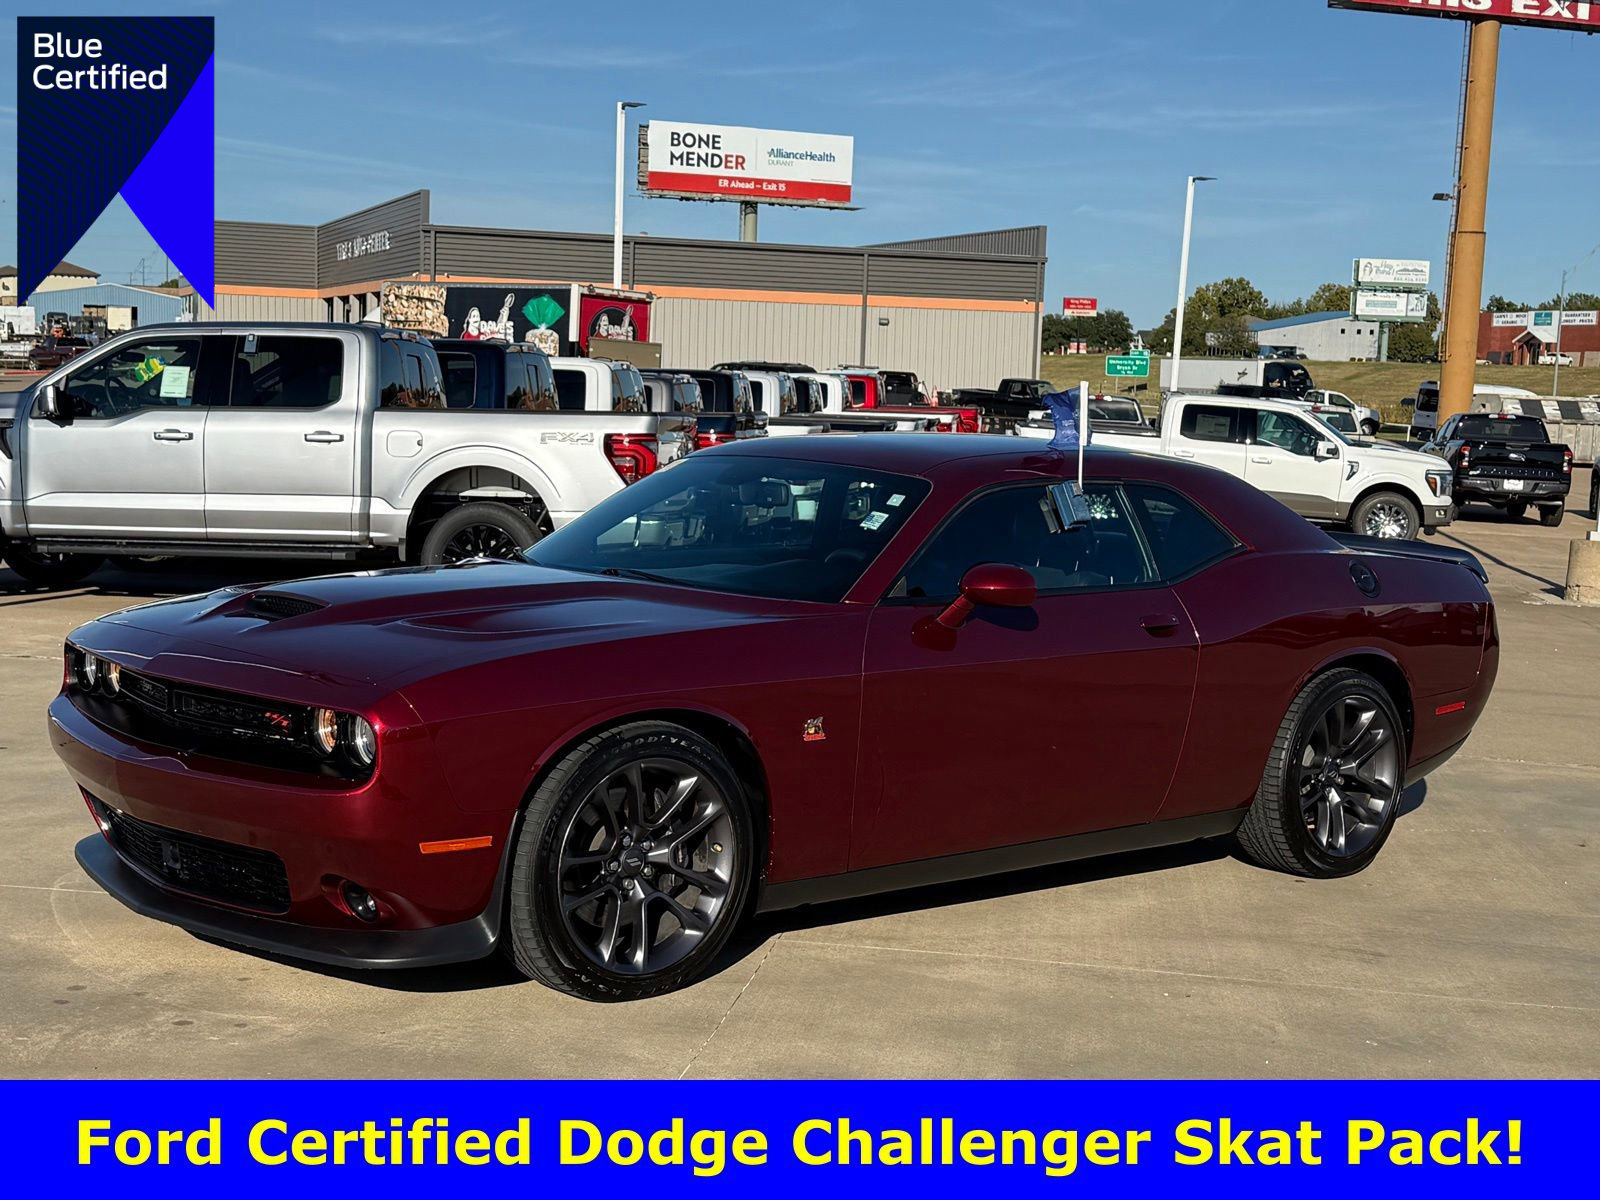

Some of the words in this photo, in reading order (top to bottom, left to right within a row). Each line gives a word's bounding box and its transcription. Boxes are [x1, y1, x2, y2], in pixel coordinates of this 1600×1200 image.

[1511, 0, 1600, 20] EXI
[670, 131, 722, 150] BONE
[669, 150, 746, 170] MENDER
[768, 148, 836, 162] AllianceHealth
[718, 179, 729, 188] ER
[730, 180, 754, 190] Ahead
[763, 182, 777, 191] Exit
[540, 431, 595, 445] FX4
